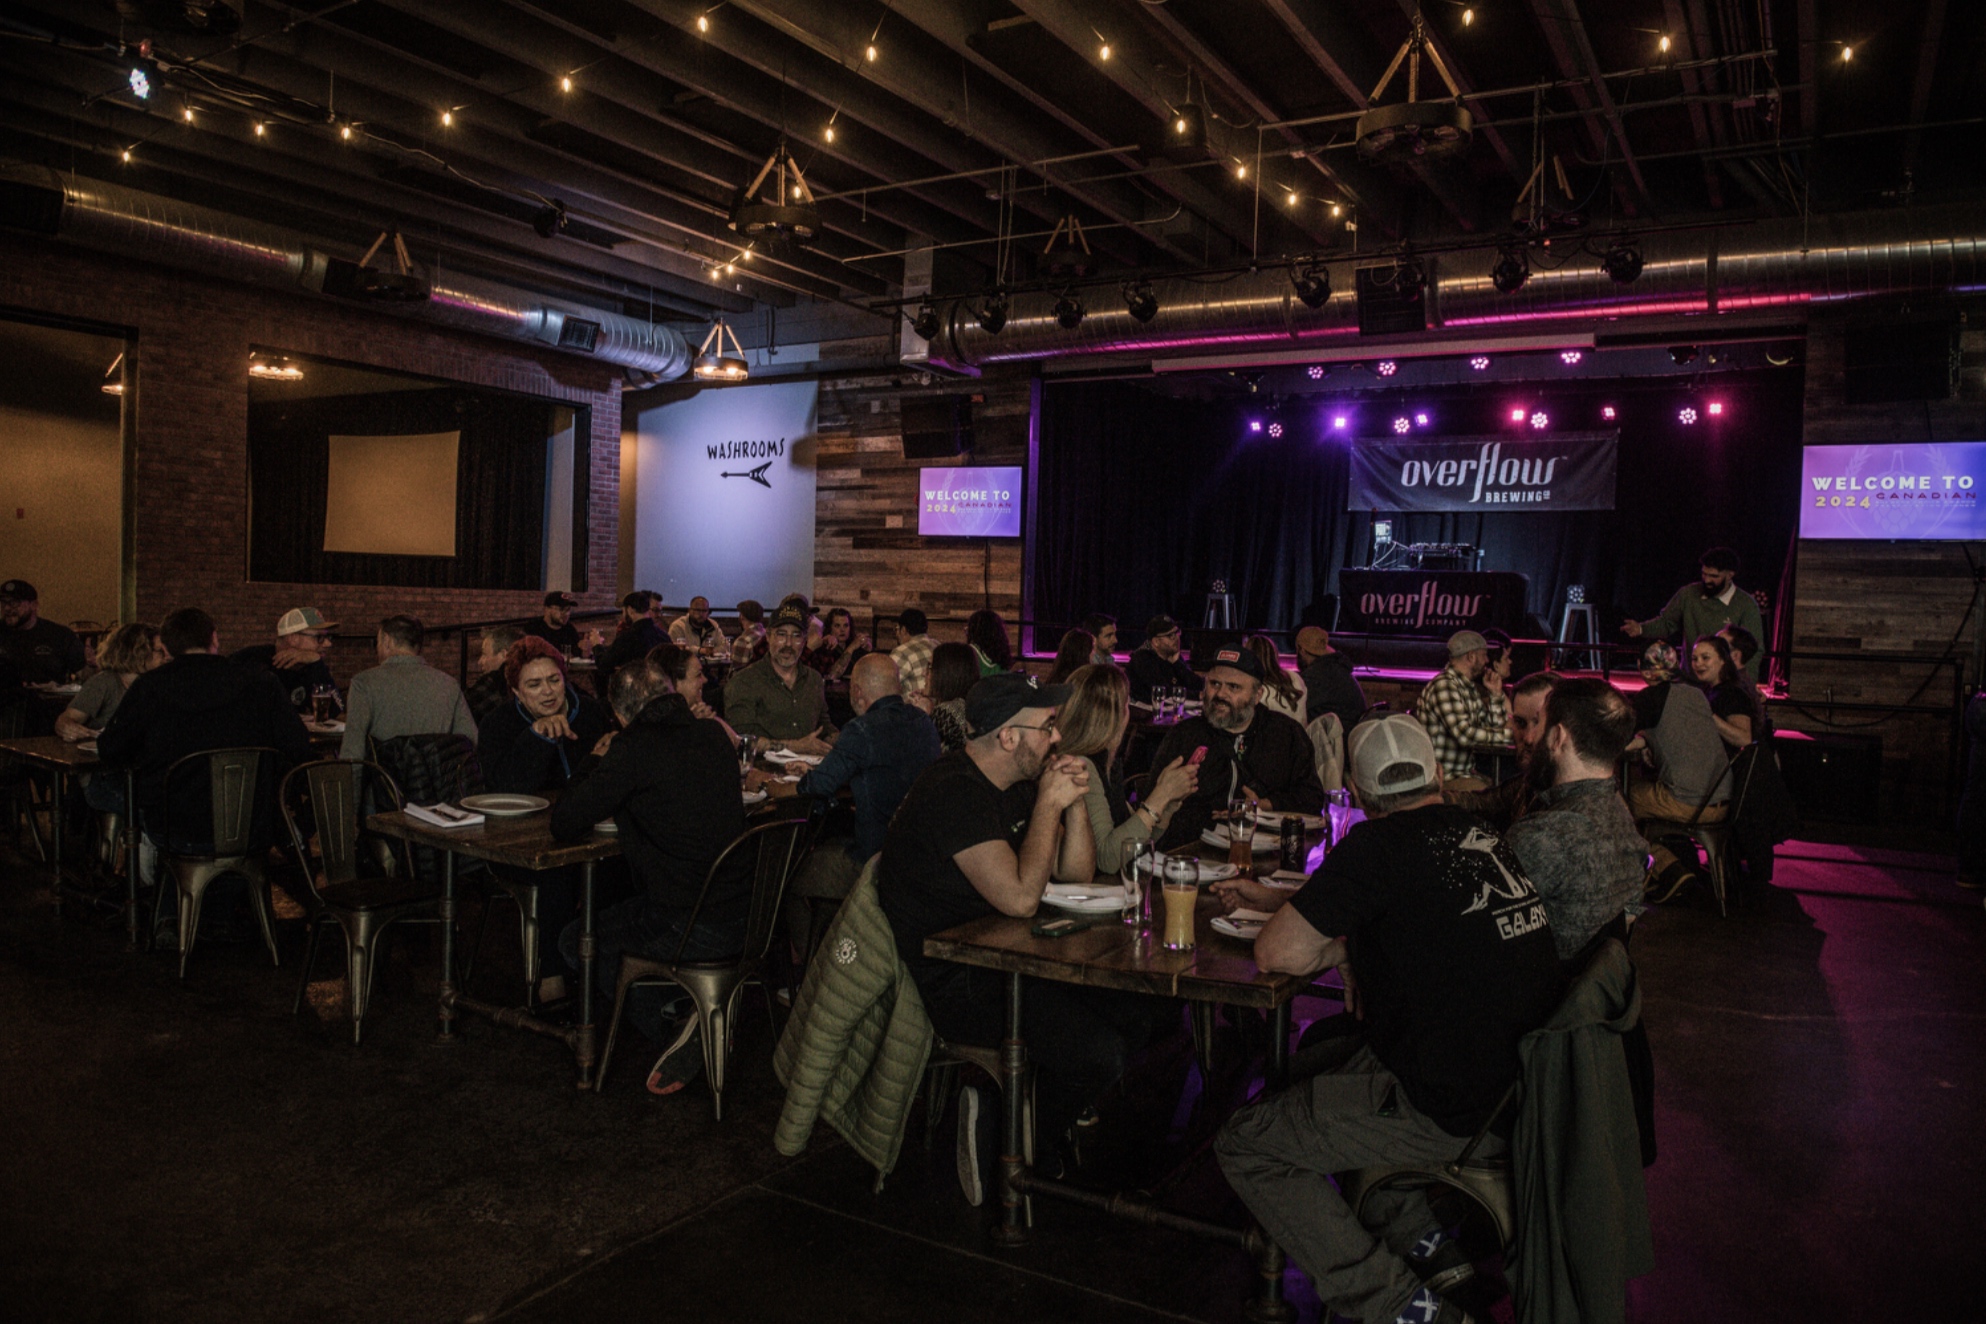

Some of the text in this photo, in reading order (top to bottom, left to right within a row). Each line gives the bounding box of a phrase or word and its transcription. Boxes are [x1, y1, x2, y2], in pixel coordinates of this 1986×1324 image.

[707, 437, 785, 460] WASHROOMS
[1401, 442, 1560, 503] overflow
[1812, 475, 1974, 491] WELCOME TO
[924, 490, 1010, 501] WELCOME TO
[1485, 491, 1543, 503] BREWING
[1815, 496, 1871, 509] 2024
[1876, 492, 1977, 500] CANADIAN
[926, 504, 957, 514] 2024
[1360, 580, 1483, 629] overflow
